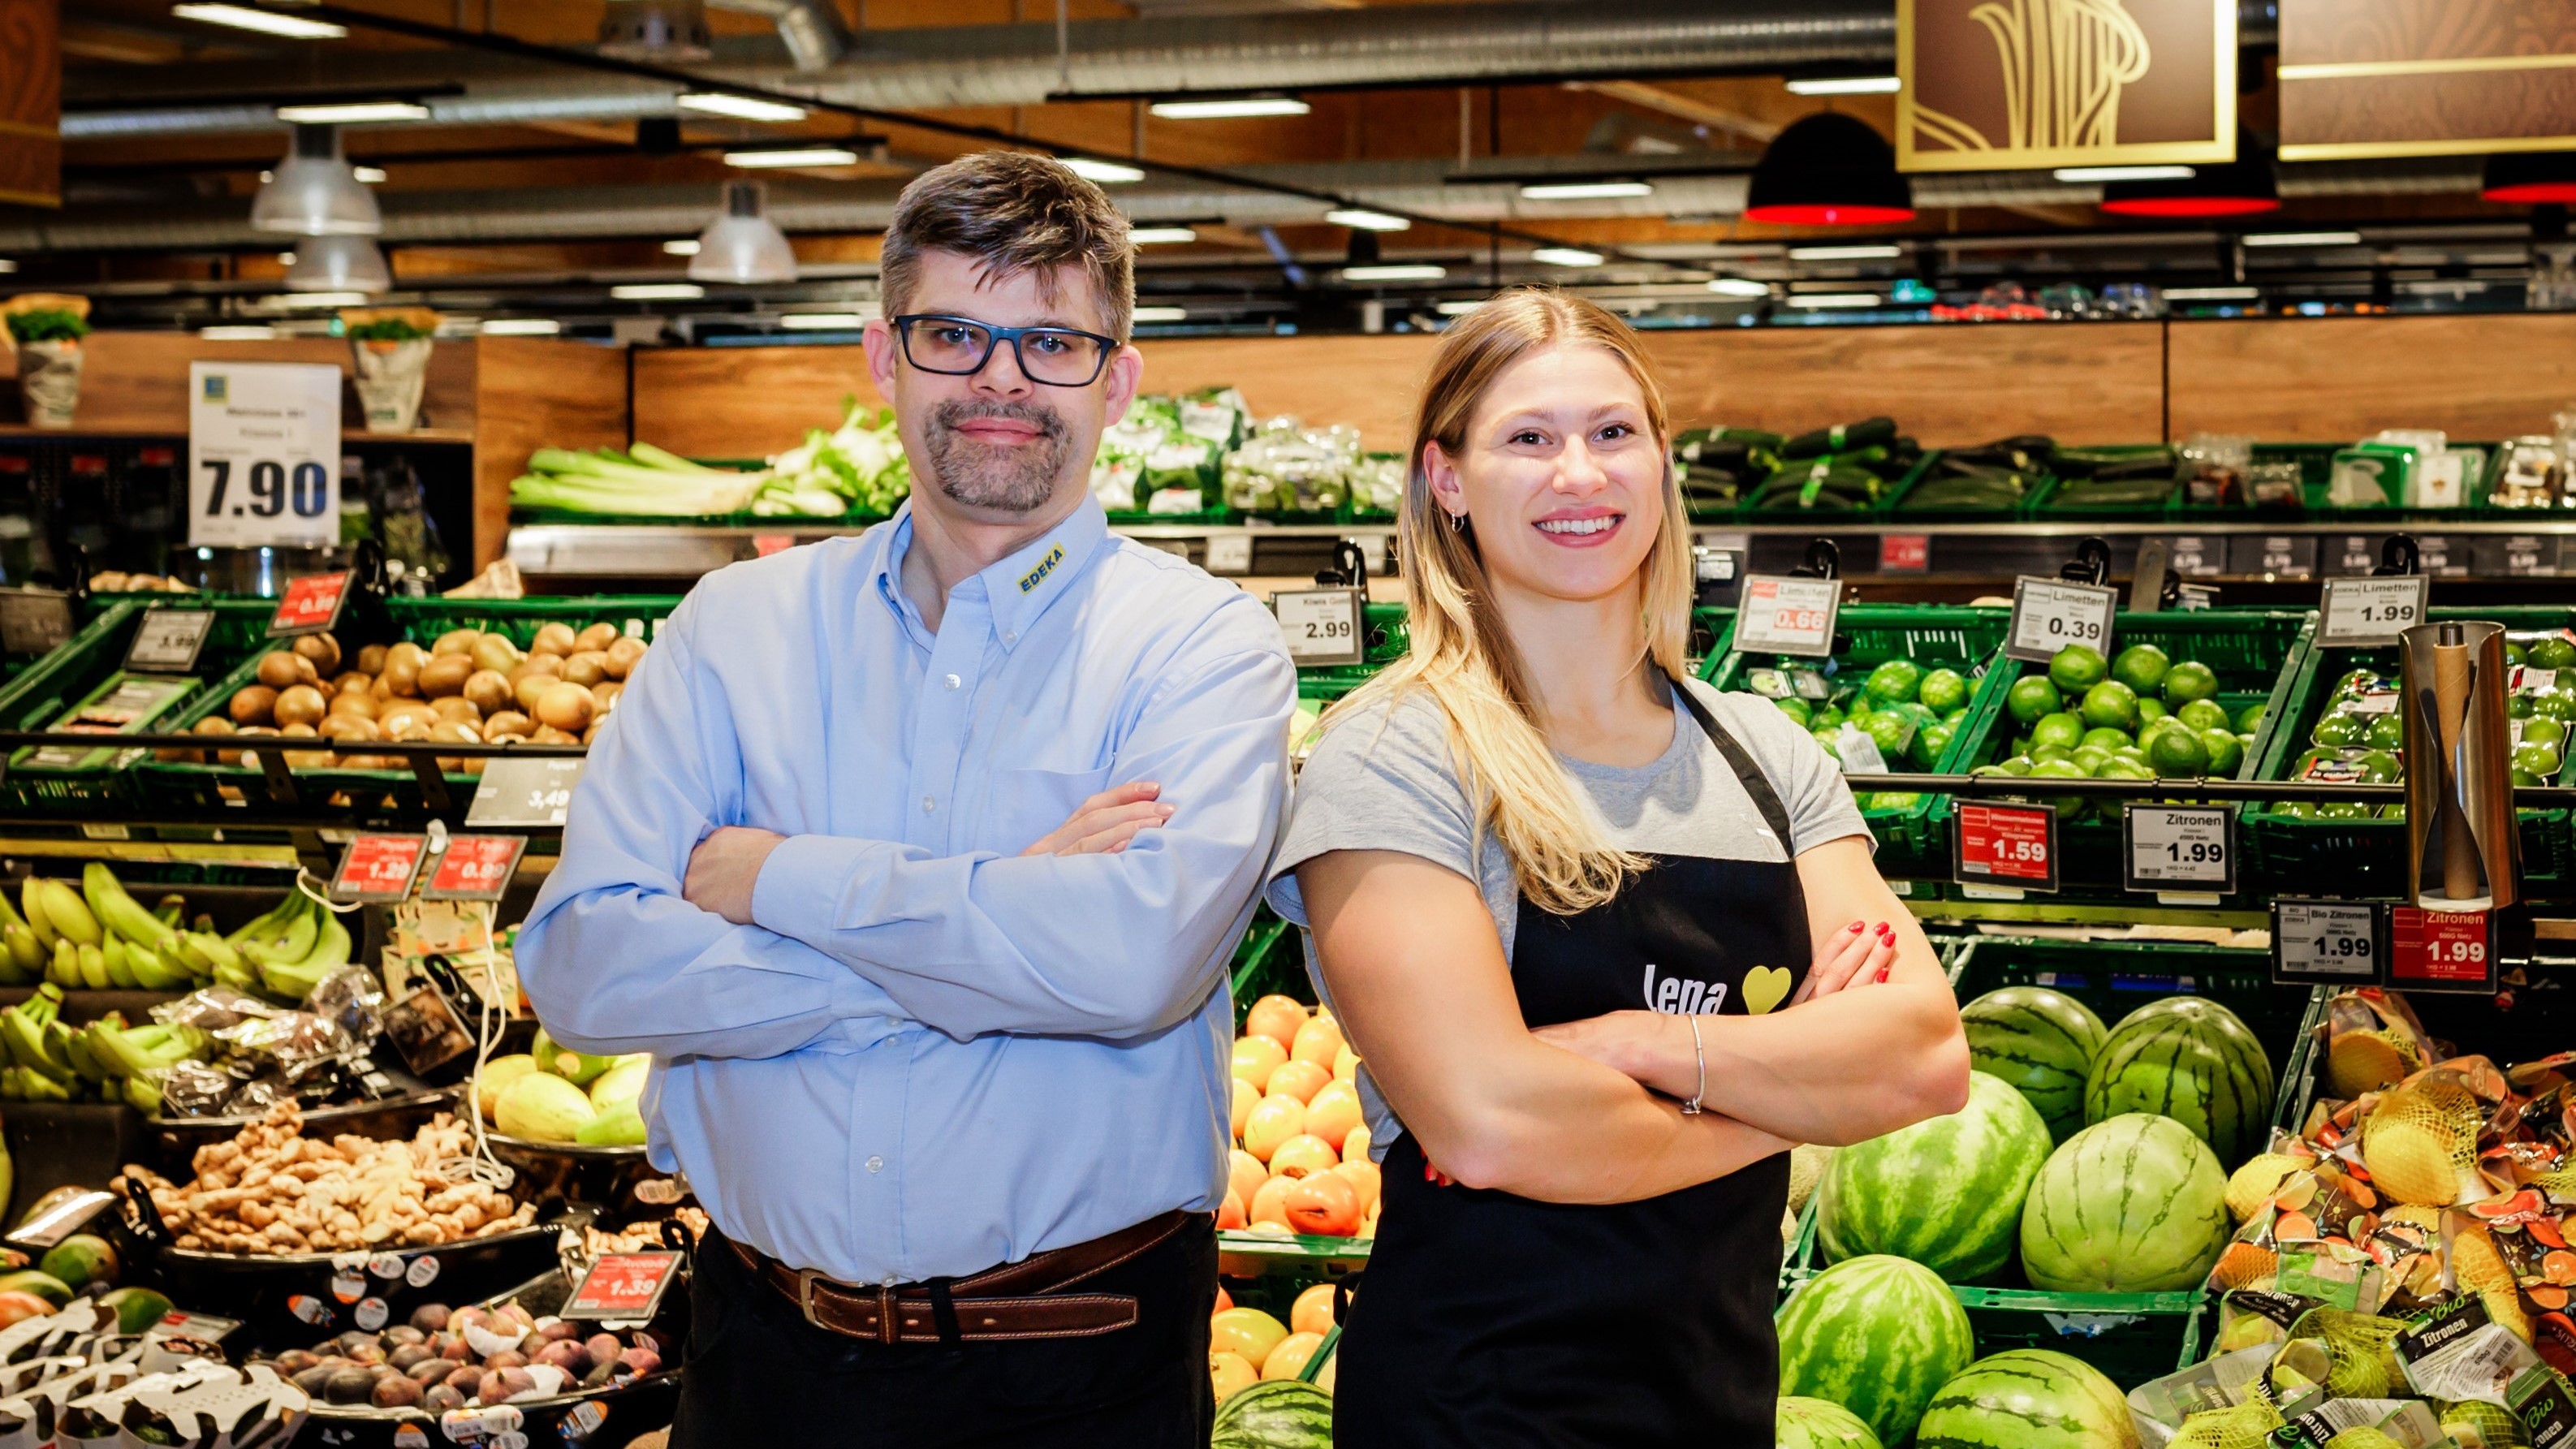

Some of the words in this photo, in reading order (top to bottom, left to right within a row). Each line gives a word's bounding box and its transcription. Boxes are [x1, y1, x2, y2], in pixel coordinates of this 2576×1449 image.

[201, 460, 327, 518] 7.90
[1020, 549, 1063, 593] EDEKA
[2053, 590, 2105, 606] Limetten
[2363, 583, 2418, 593] Limetten
[1775, 610, 1826, 630] 0.66
[2361, 605, 2414, 622] 1.99
[1305, 621, 1351, 639] 2.99
[2048, 617, 2100, 640] 0.39
[2166, 813, 2222, 826] Zitronen
[1992, 839, 2047, 862] 1.59
[2167, 842, 2224, 863] 1.99
[2311, 910, 2328, 919] Bio
[2329, 910, 2370, 920] Zitronen
[2427, 912, 2484, 925] Zitronen
[2314, 936, 2371, 957] 1.99
[2427, 940, 2485, 963] 1.99
[1643, 964, 1728, 1016] Lena
[611, 1279, 658, 1296] 1.39
[2431, 1296, 2466, 1322] Bio
[2420, 1317, 2469, 1348] Zitronen
[2524, 1398, 2554, 1429] Bio
